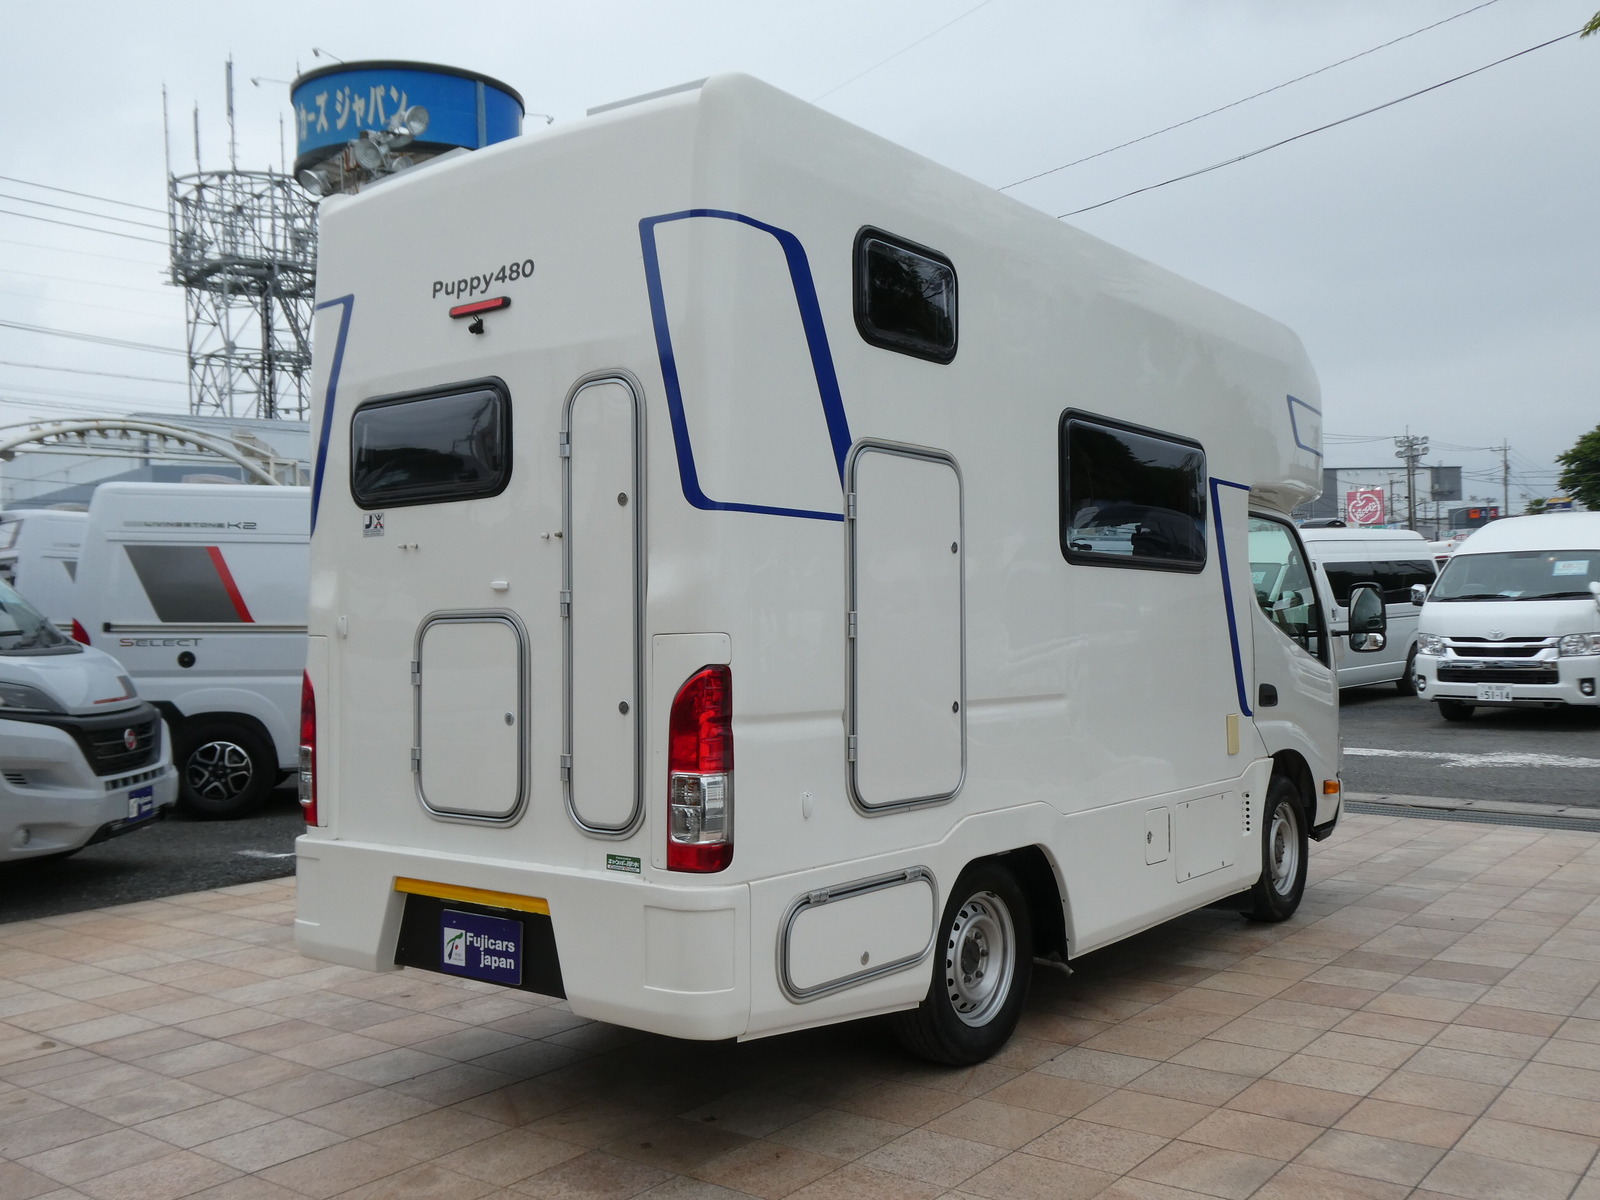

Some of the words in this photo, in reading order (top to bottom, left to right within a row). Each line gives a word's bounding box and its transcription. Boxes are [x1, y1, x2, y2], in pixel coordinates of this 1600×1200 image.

[432, 259, 535, 299] Puppy480
[227, 522, 257, 530] K2
[119, 638, 202, 647] SELECT
[466, 932, 515, 952] Fujicars
[480, 952, 514, 969] japan
